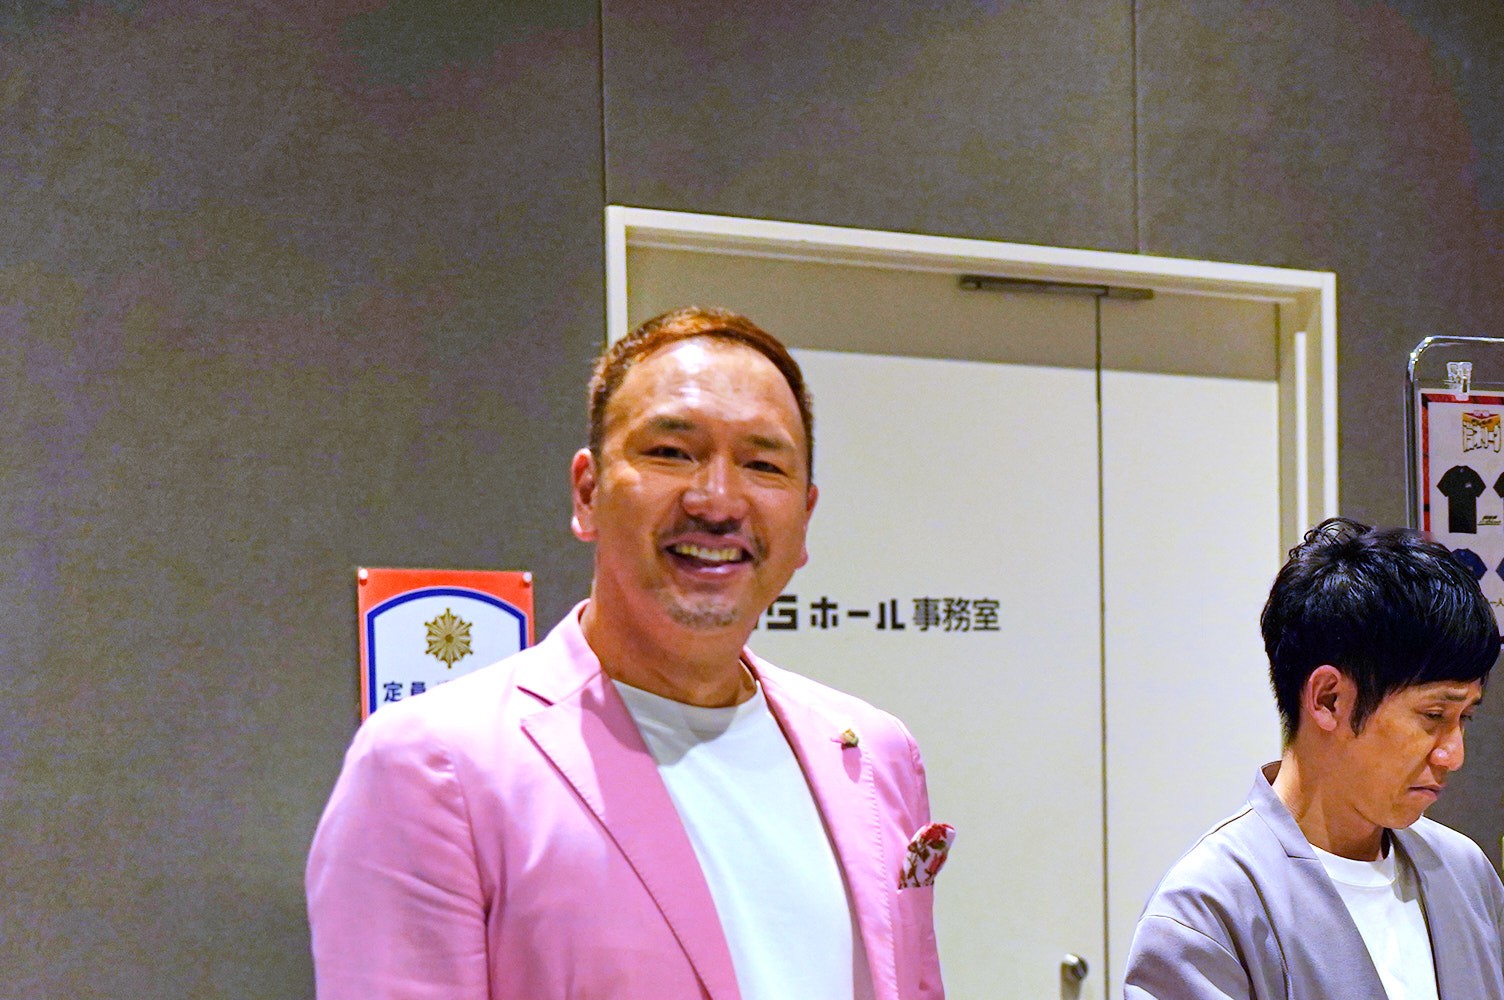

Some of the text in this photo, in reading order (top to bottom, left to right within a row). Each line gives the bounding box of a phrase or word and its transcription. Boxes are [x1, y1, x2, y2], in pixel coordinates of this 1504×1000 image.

[753, 595, 1001, 632] Sホール事務室
[383, 681, 450, 702] 定員
